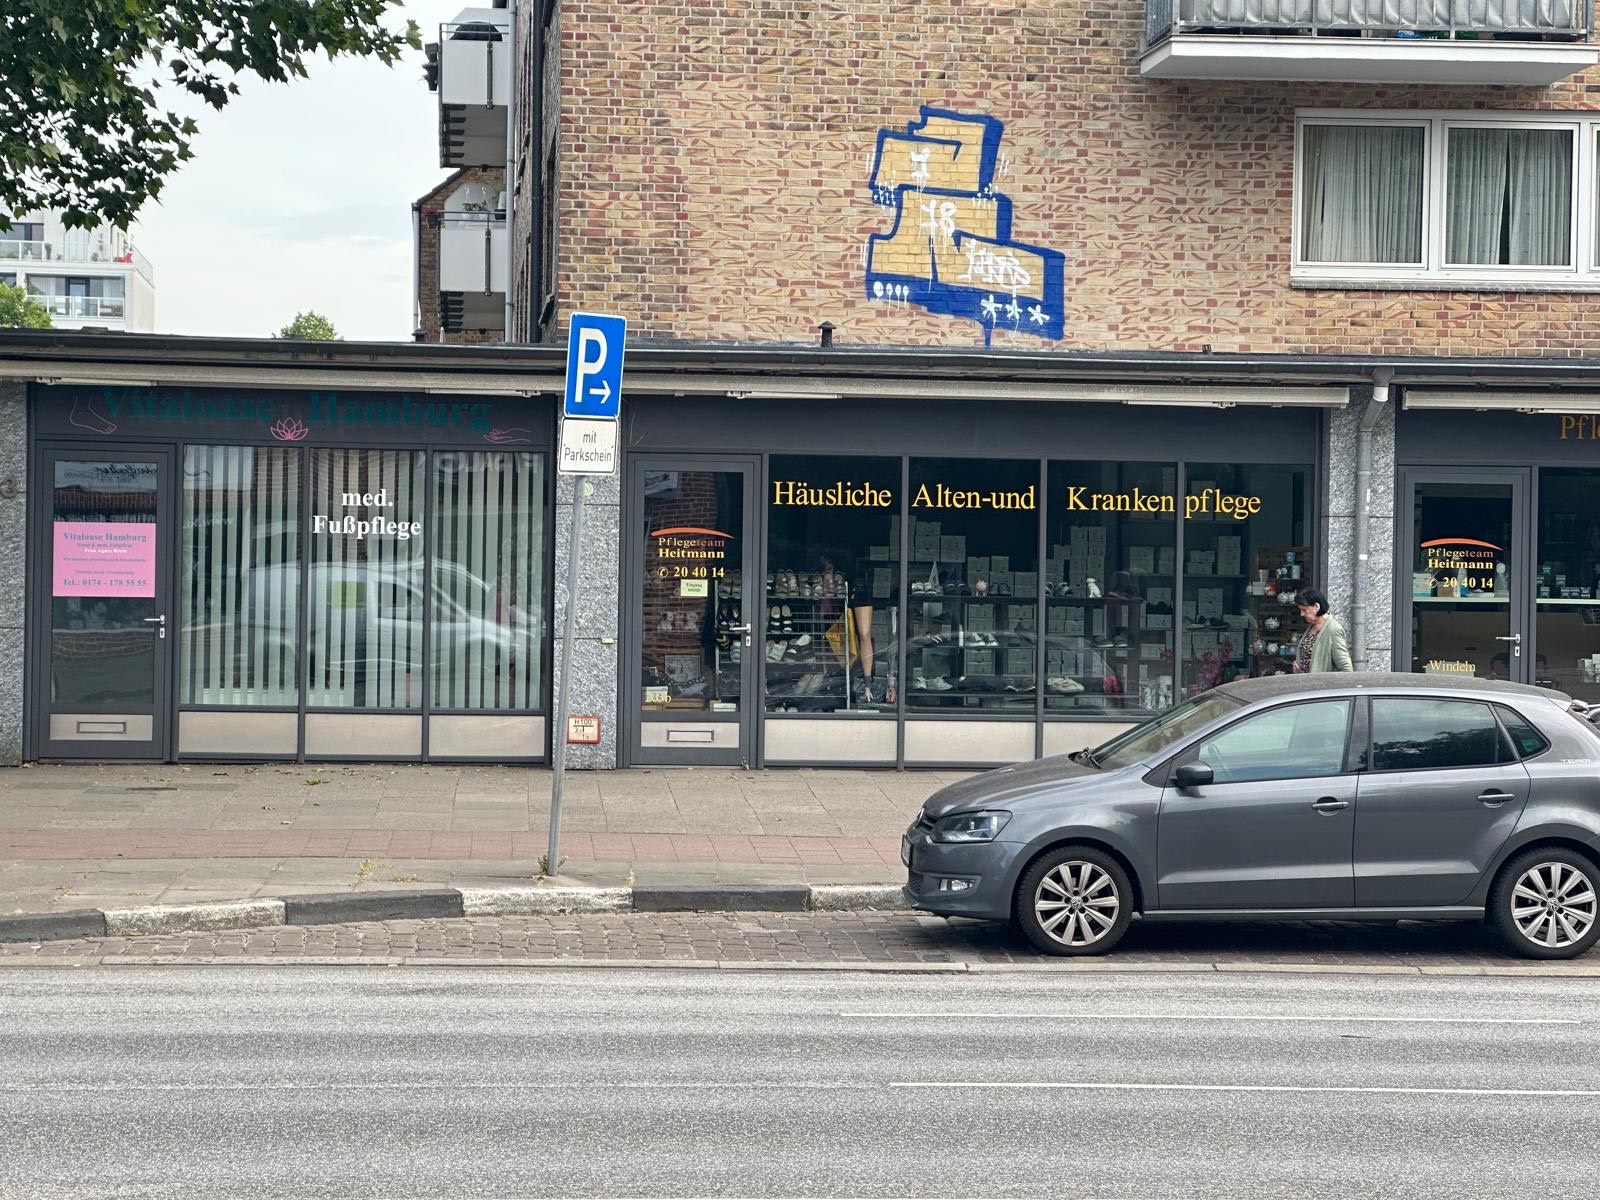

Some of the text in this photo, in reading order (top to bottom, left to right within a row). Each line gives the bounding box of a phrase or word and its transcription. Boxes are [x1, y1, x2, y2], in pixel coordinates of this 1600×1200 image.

[574, 327, 608, 403] P
[102, 387, 491, 433] Vitaloase Hamburg
[1559, 415, 1600, 440] Pfl
[582, 431, 597, 444] mit
[564, 447, 612, 462] Parkschein
[341, 488, 394, 507] med.
[773, 481, 1261, 520] Häusliche Alten-und Kranken pflege
[312, 515, 422, 540] Fußpflege
[64, 532, 147, 542] Vitaloase Hamburg
[658, 537, 725, 549] Pflegeteam
[658, 548, 725, 559] Heitmann
[1428, 548, 1494, 560] Pflegeteam
[1428, 558, 1494, 570] Heitmann
[673, 566, 725, 578] 20 40 14
[1442, 577, 1494, 588] 20 40 14
